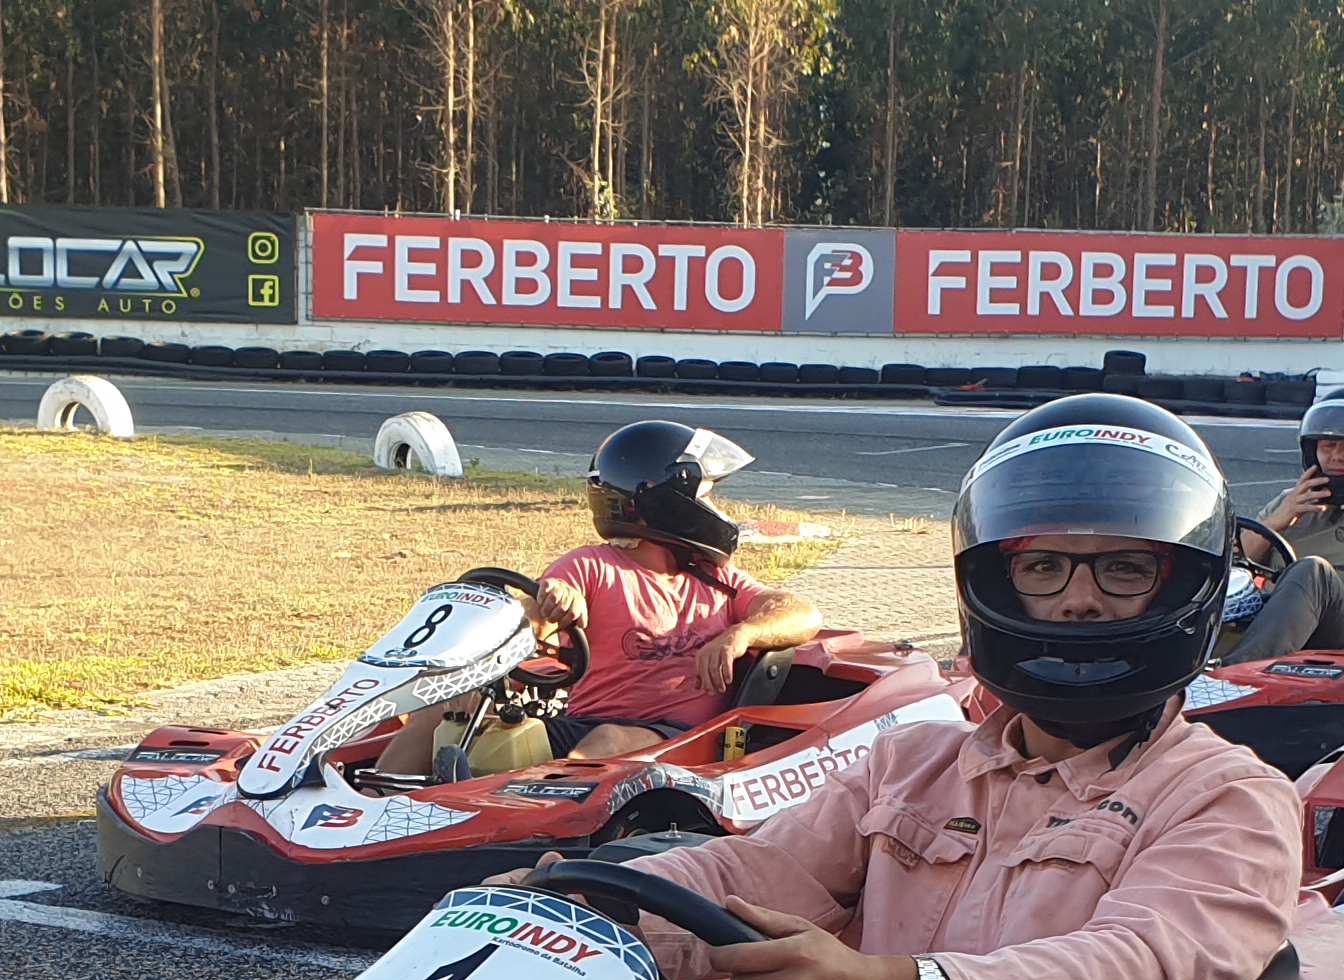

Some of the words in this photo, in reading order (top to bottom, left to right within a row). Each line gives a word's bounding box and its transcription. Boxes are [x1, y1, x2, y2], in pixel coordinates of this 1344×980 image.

[344, 233, 757, 313] FERBERTO
[928, 250, 1324, 320] FERBERTO
[99, 298, 177, 314] AUTO
[1028, 429, 1151, 446] EUROINDY
[420, 591, 496, 605] EUROINDY
[403, 603, 453, 649] 8
[256, 678, 380, 773] FERBERTO
[430, 910, 604, 963] EUROINDY
[552, 957, 587, 978] Batalha
